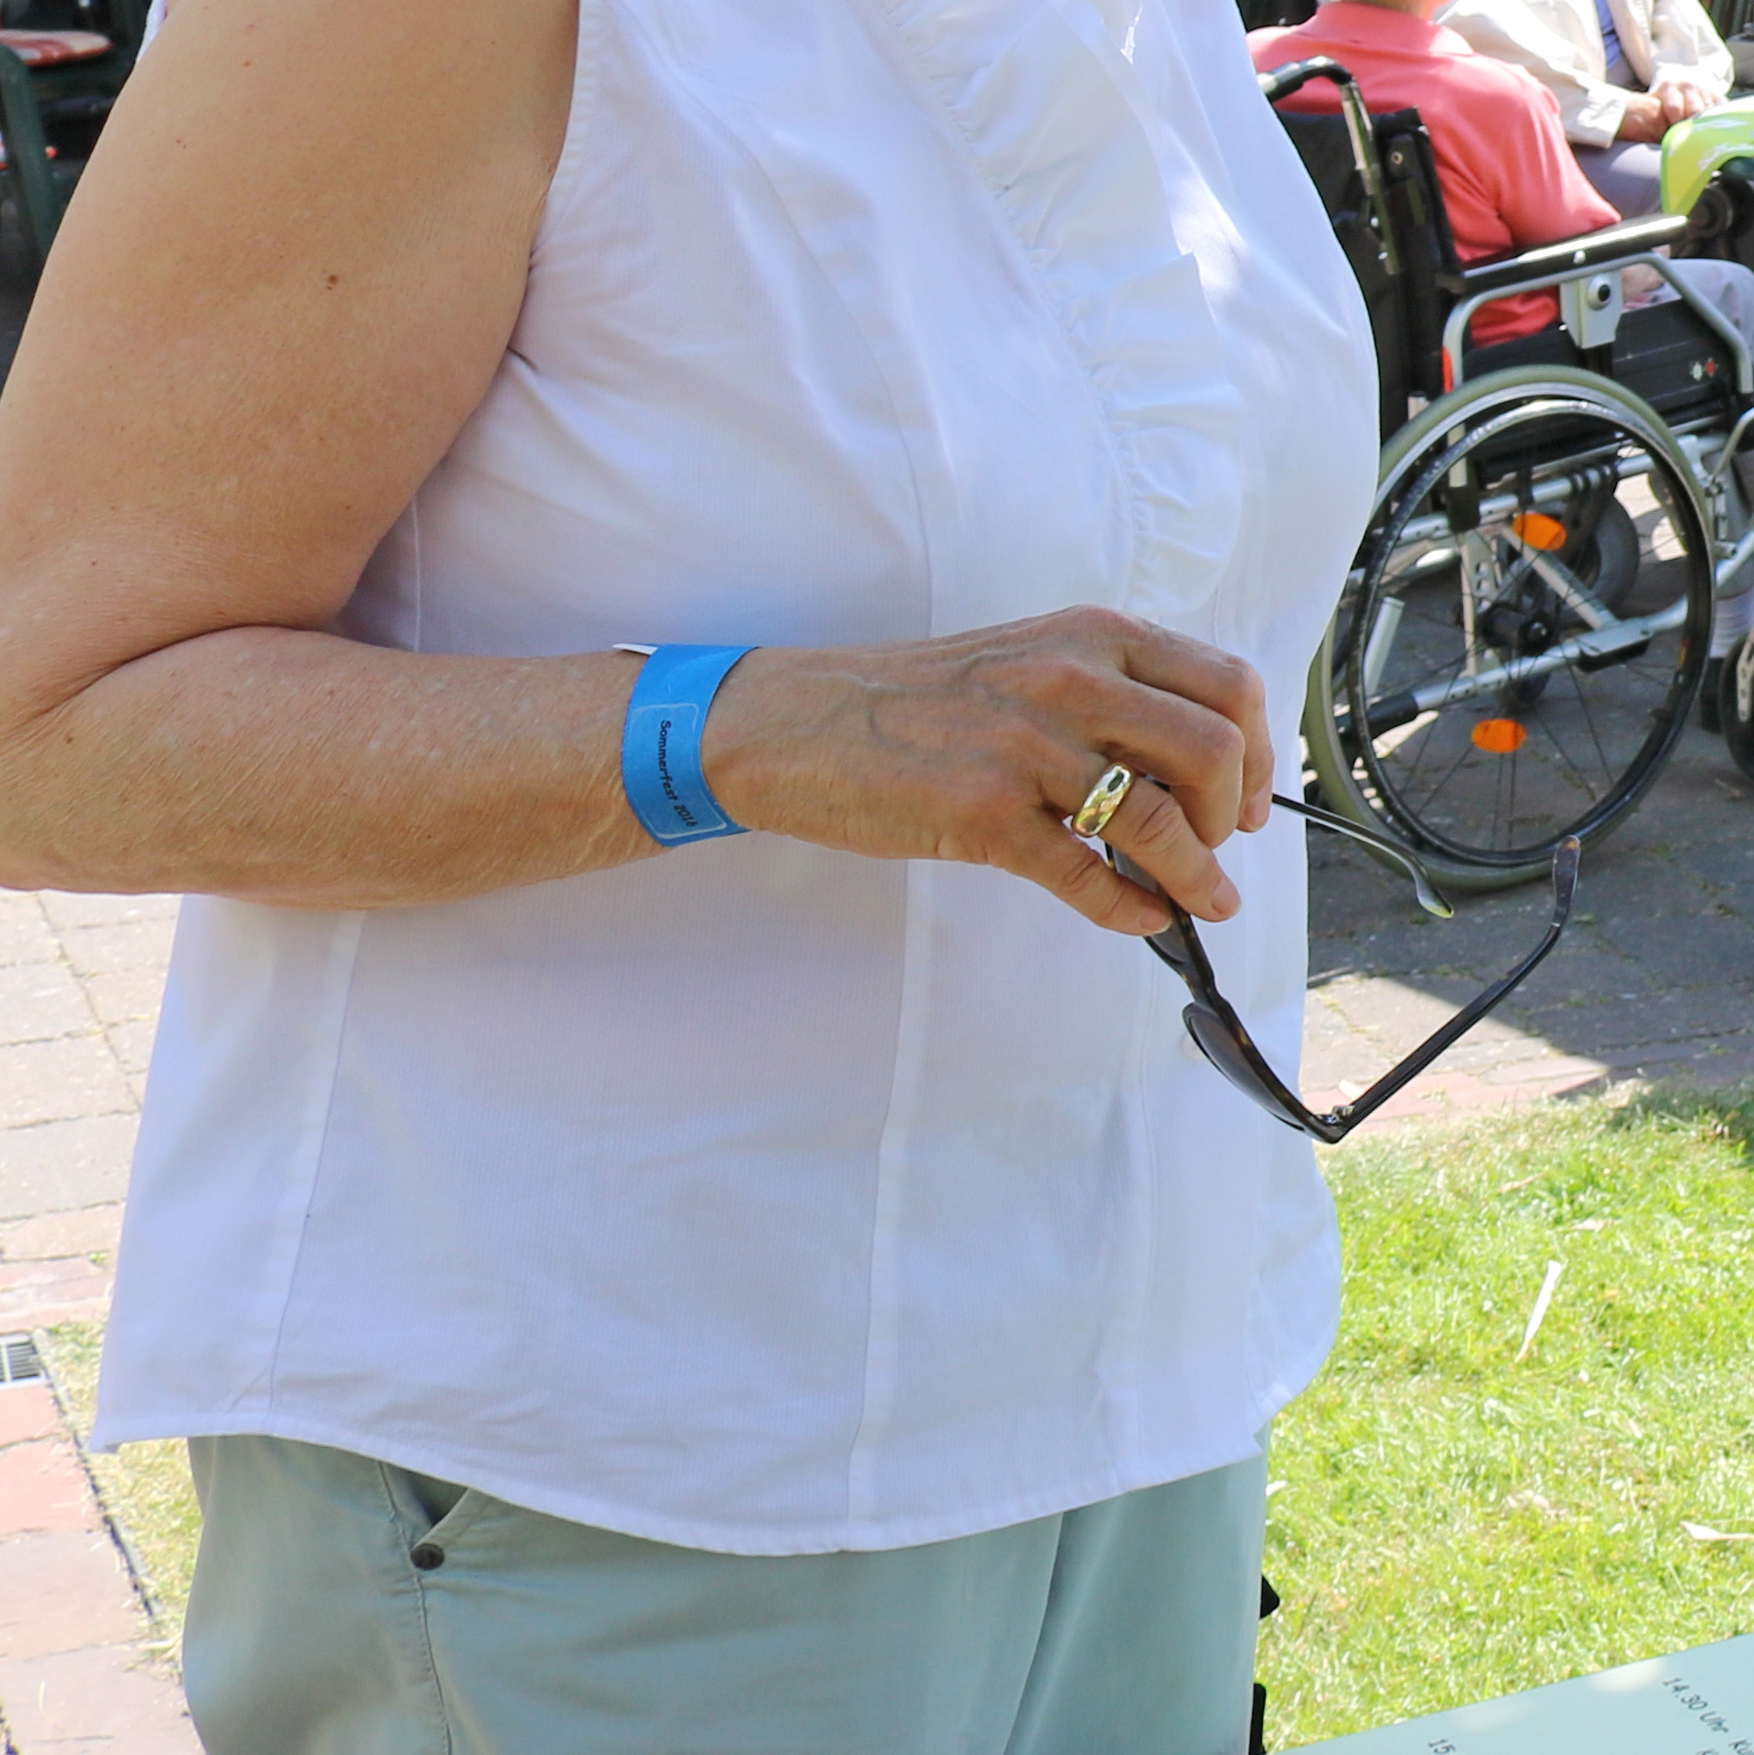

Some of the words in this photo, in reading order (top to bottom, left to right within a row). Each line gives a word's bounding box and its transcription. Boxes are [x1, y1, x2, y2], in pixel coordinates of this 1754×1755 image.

[658, 719, 679, 801] Sommerfest
[1661, 1677, 1709, 1712] 14.30
[1699, 1710, 1730, 1734] Uhr
